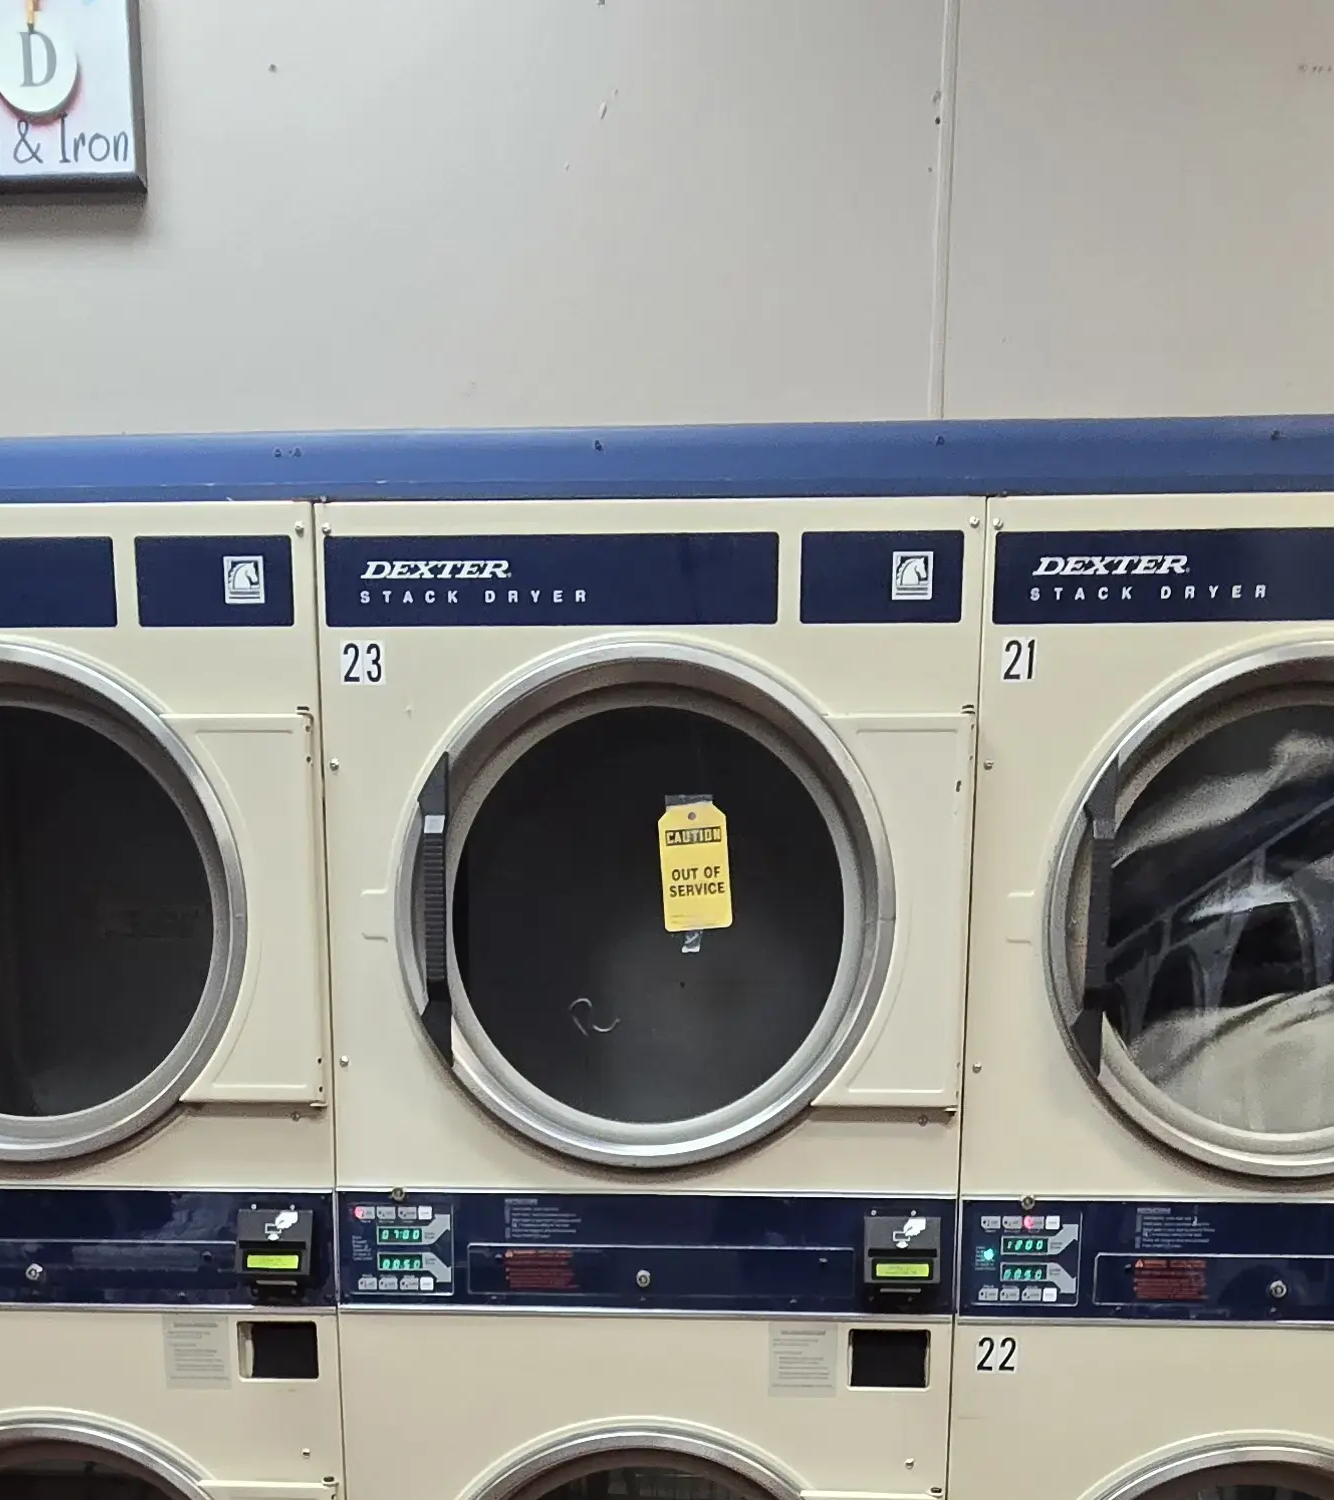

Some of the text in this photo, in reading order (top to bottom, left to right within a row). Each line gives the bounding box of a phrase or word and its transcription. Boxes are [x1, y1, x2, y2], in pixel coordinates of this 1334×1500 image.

[12, 119, 43, 164] &
[59, 113, 129, 164] Iron
[360, 560, 510, 580] DEXTER
[1032, 554, 1188, 576] DEXTER
[360, 588, 587, 604] STACK DRYER
[1029, 584, 1267, 601] STACK DRYER
[342, 642, 383, 683] 23
[1003, 639, 1036, 681] 21
[666, 828, 721, 844] CAUTION
[671, 866, 721, 881] OUT OF
[669, 882, 725, 898] SERVICE
[975, 1335, 1016, 1373] 22
